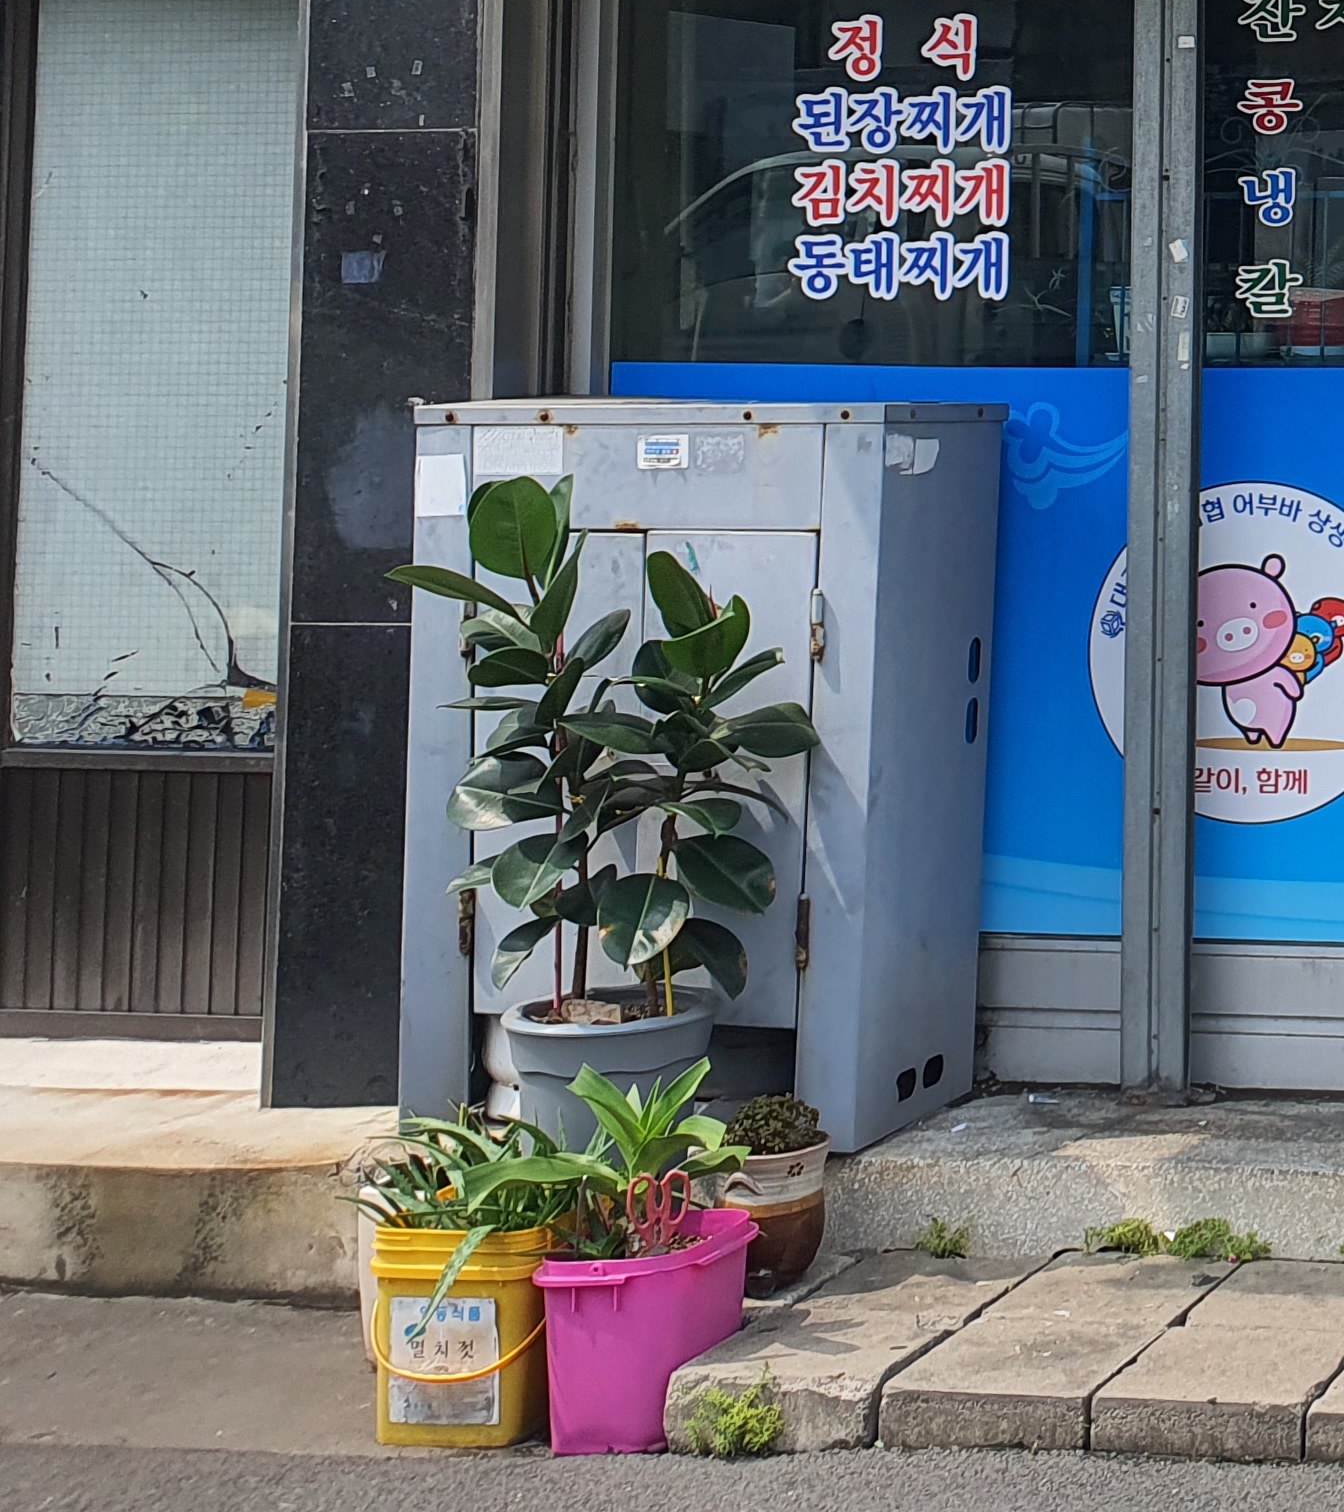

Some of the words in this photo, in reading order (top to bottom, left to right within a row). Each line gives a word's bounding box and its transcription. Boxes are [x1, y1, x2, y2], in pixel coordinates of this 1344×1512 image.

[793, 85, 1013, 155] 된장찌개
[792, 157, 1012, 227] 김치찌개
[789, 231, 1010, 301] 동태찌개
[1232, 493, 1304, 523] 어부바
[1256, 766, 1309, 796] 함께
